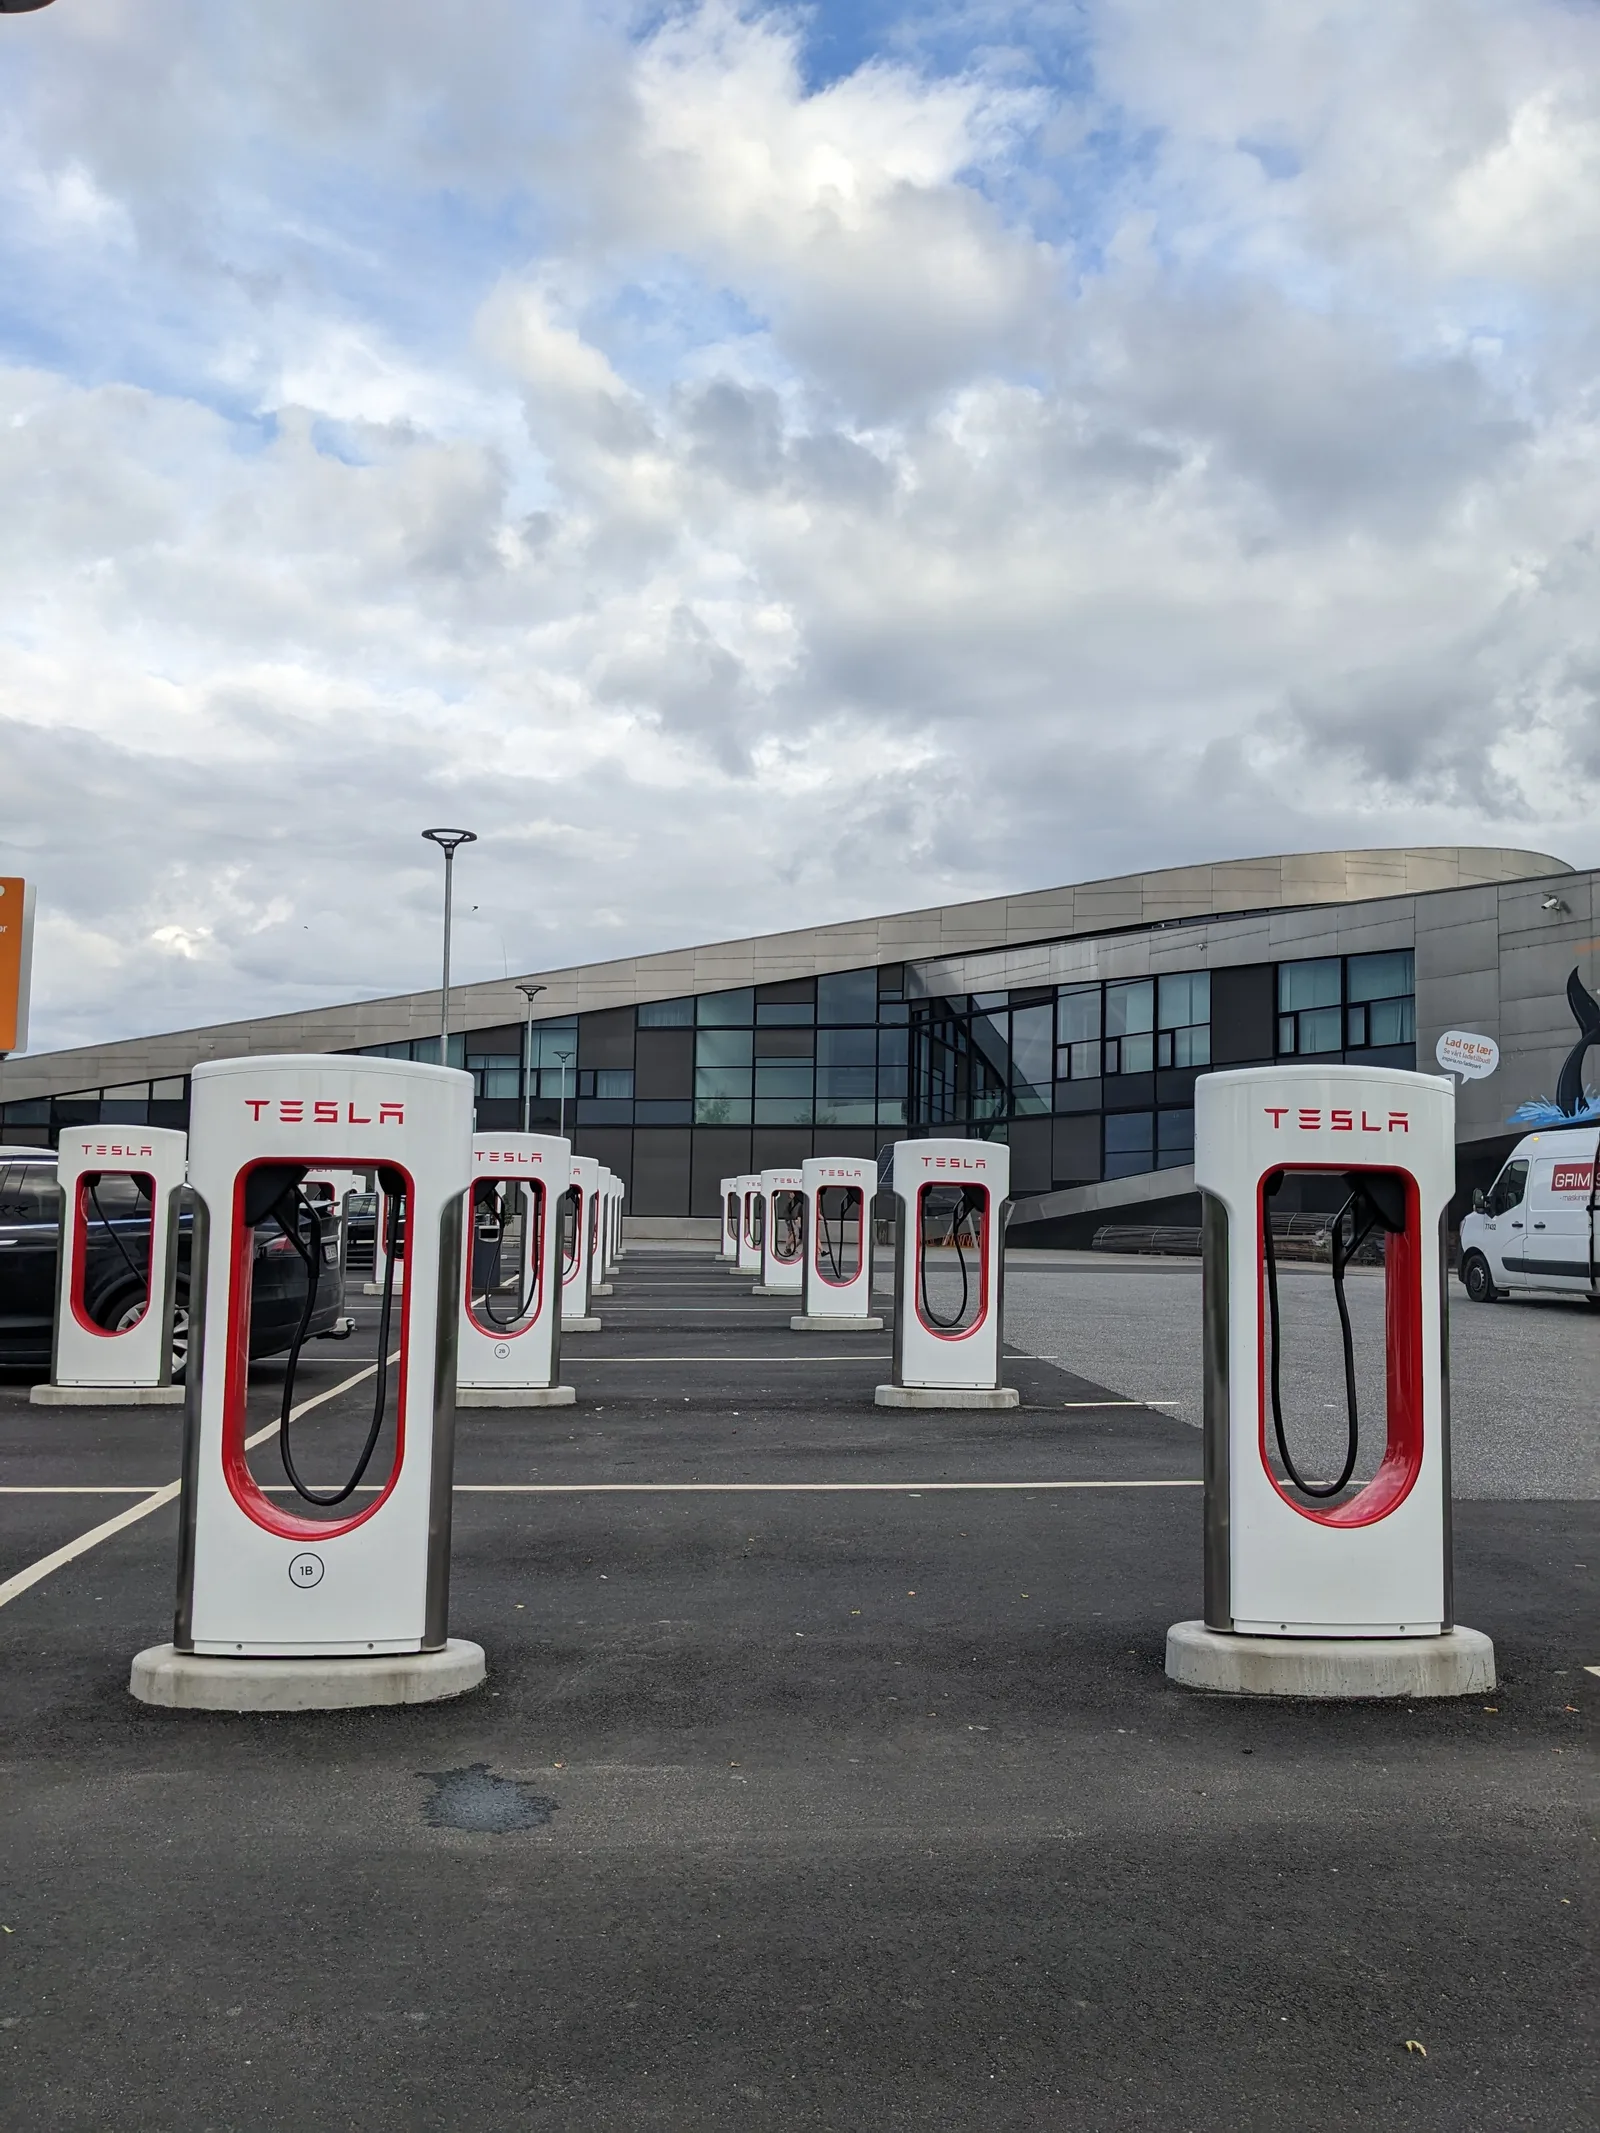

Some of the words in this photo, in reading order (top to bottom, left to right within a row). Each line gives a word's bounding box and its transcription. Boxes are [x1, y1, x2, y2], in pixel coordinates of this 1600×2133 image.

[1445, 1036, 1462, 1048] Lad
[1463, 1043, 1475, 1054] og
[1476, 1043, 1493, 1055] lær
[244, 1100, 404, 1125] TESLA
[1264, 1108, 1408, 1132] TESLA
[81, 1145, 152, 1156] TESLA
[474, 1151, 542, 1163] TESLA
[921, 1157, 986, 1169] TESLA
[299, 1565, 313, 1576] 1B
